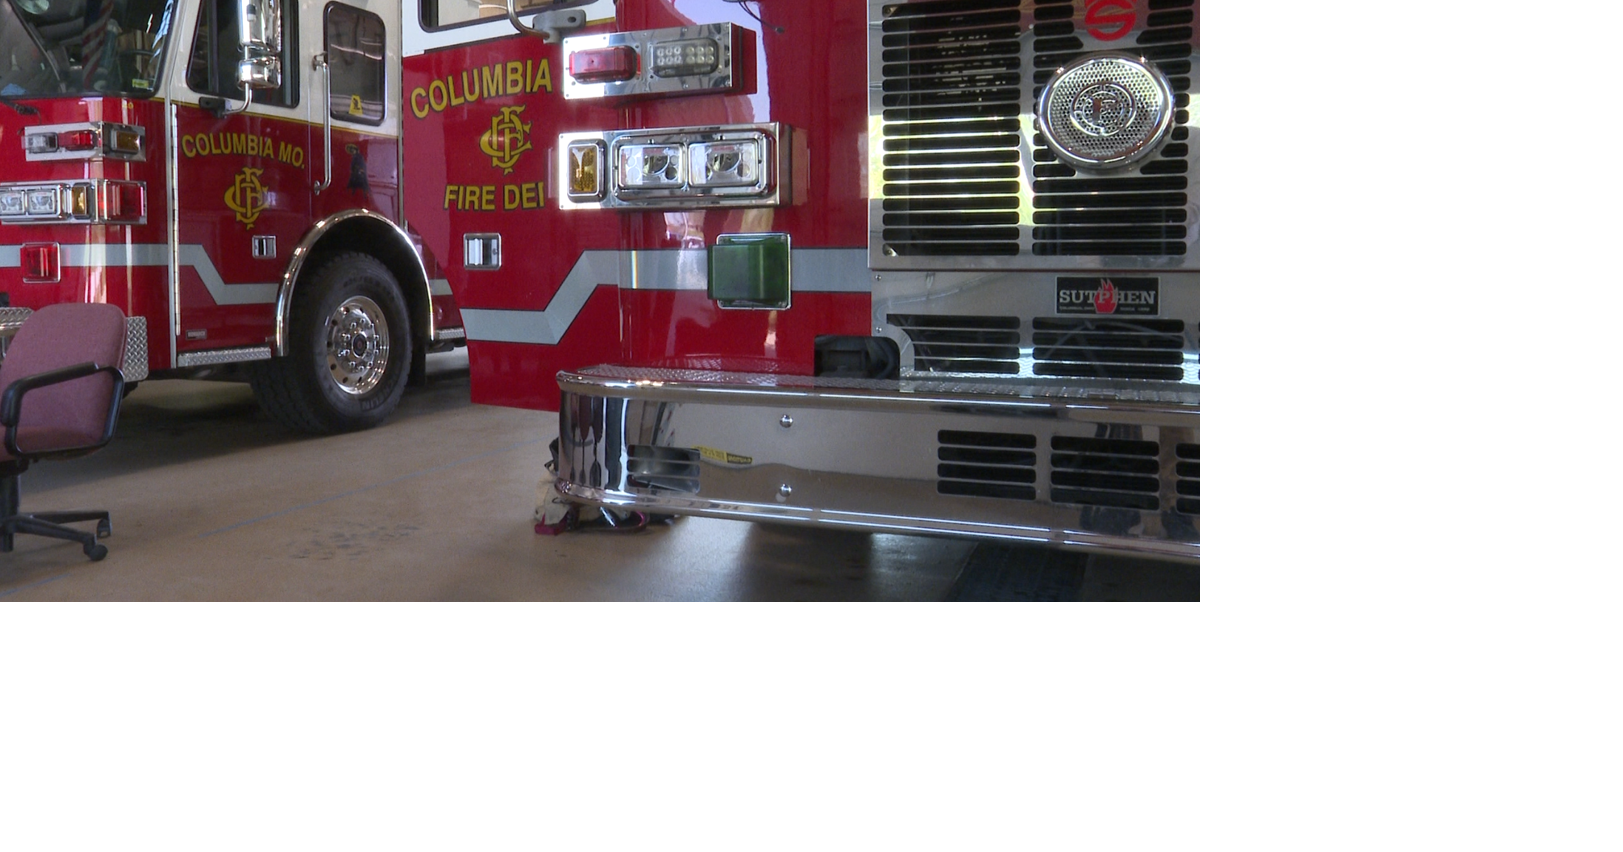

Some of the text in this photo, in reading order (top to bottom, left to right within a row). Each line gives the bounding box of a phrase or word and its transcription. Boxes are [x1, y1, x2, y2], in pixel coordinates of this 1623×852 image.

[410, 58, 553, 119] COLUMBIA
[181, 132, 305, 169] COLUMBIA MO.
[444, 184, 496, 210] FIRE
[1059, 289, 1156, 305] SUTPHEN
